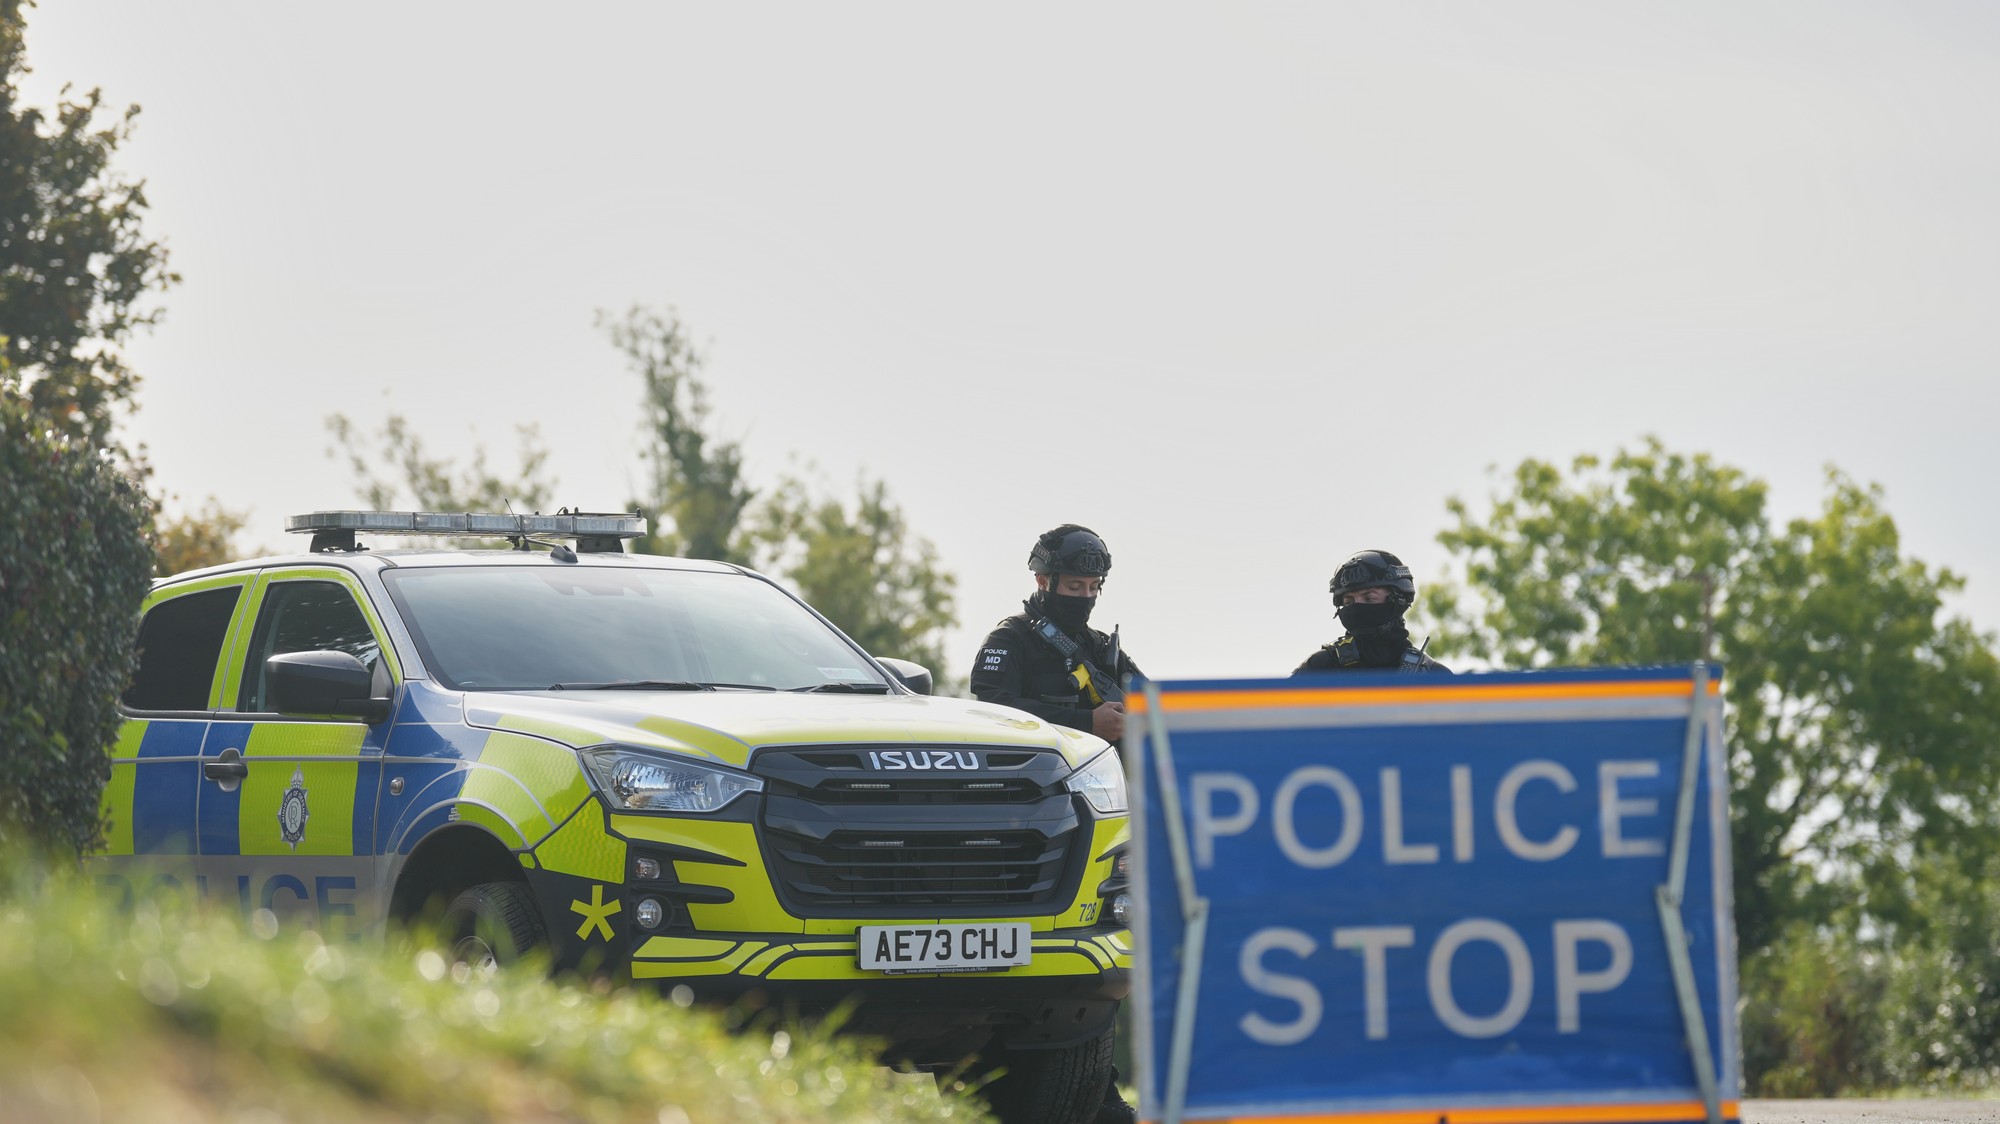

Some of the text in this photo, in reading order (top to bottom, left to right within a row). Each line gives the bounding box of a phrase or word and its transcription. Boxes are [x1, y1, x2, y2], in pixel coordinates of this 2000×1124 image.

[869, 751, 979, 770] ISUZU
[1190, 760, 1665, 869] POLICE
[94, 873, 362, 943] PICE
[875, 928, 1018, 962] AE73 CHJ
[1238, 917, 1634, 1046] STOP
